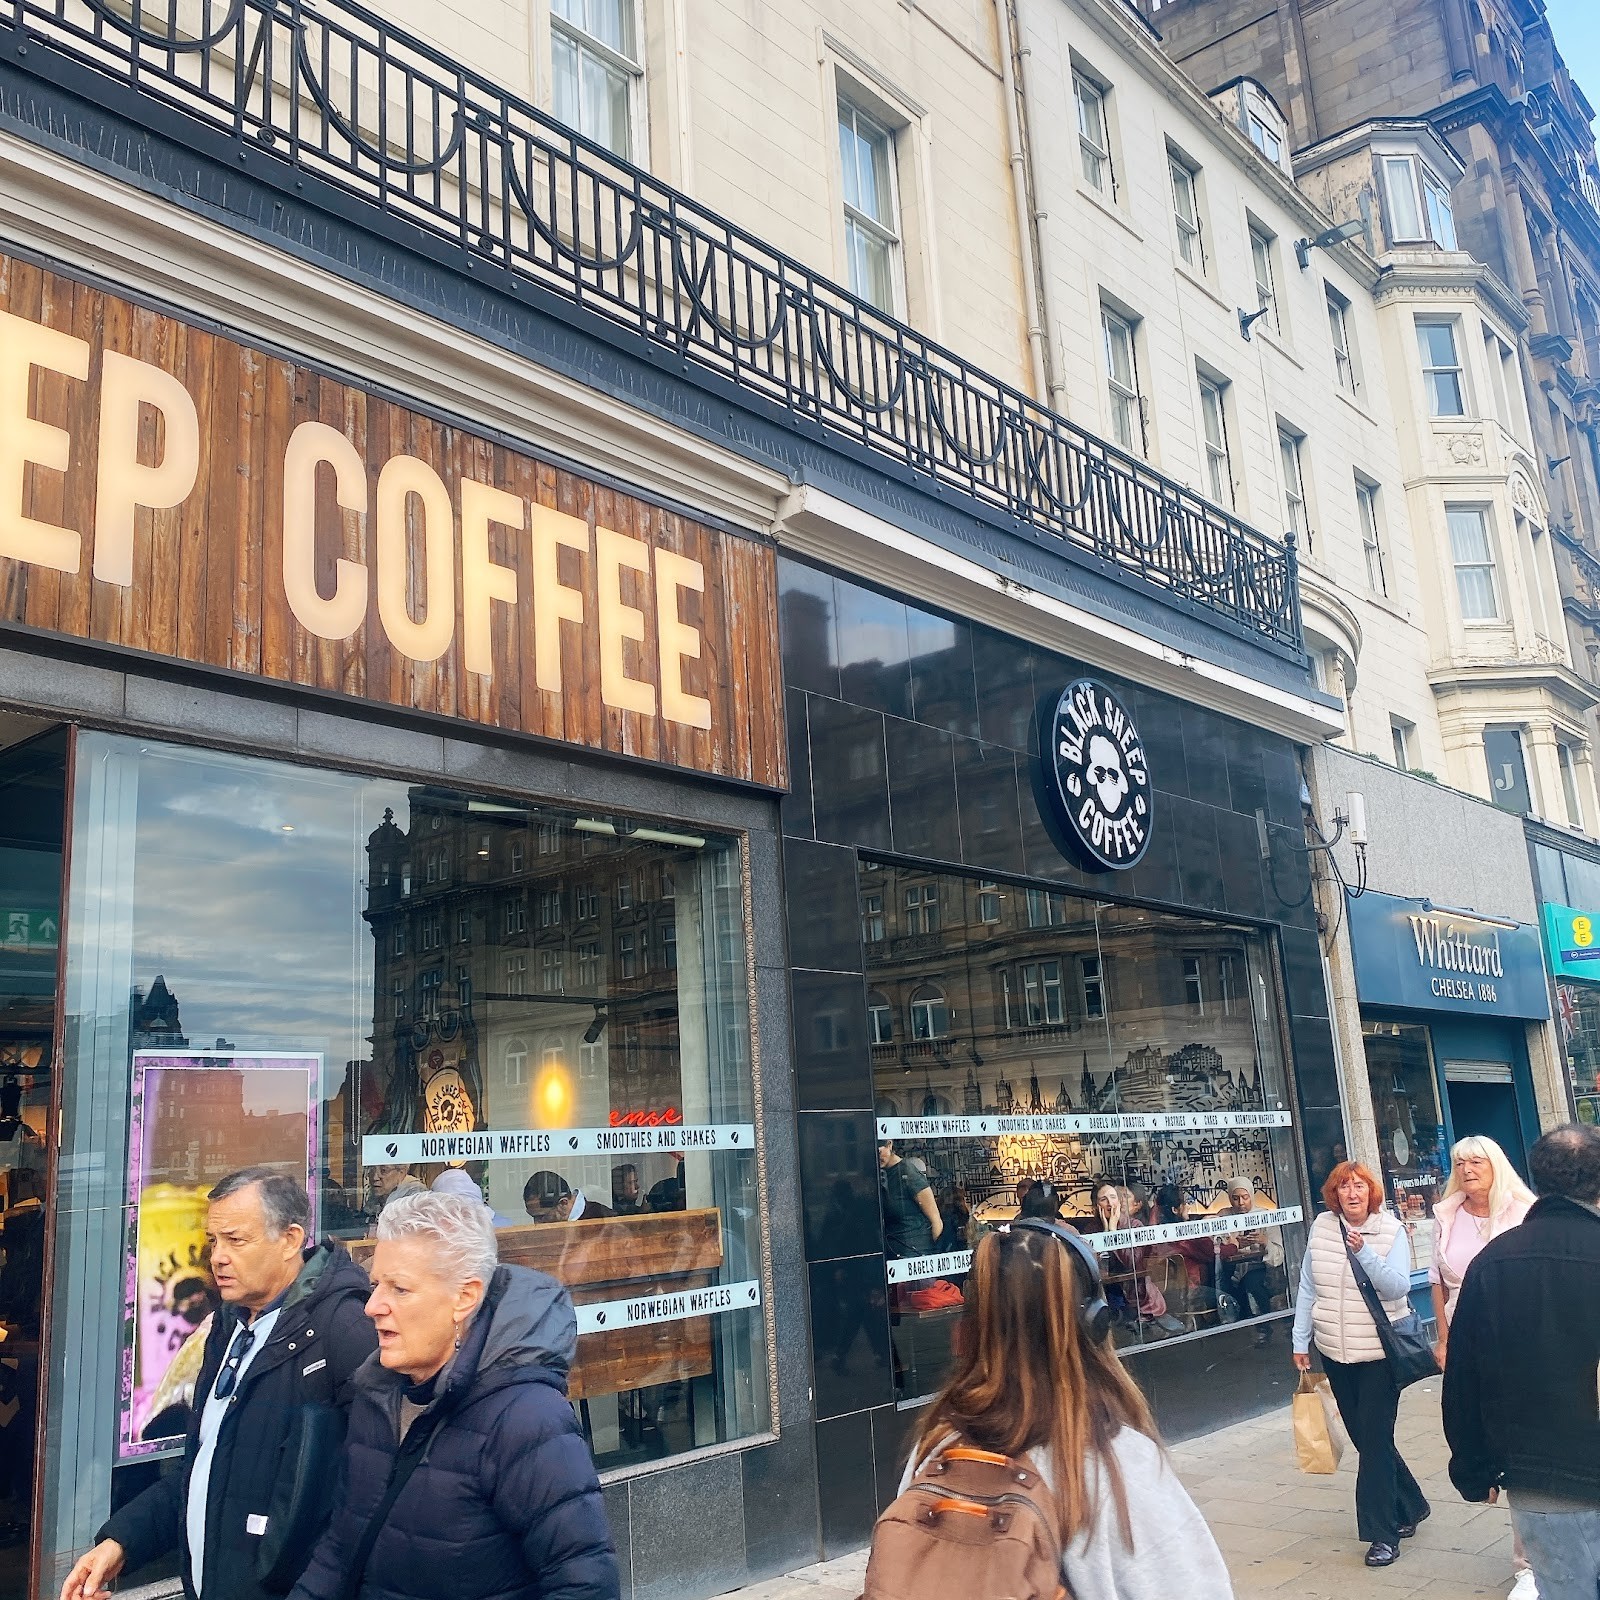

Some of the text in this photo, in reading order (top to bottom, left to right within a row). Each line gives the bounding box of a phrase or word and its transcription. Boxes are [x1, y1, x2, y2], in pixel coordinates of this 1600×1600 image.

[283, 421, 712, 731] COFFEE
[1060, 688, 1148, 786] BLACK SHEEP
[1495, 763, 1514, 791] J
[1078, 797, 1145, 858] COFFEE
[1408, 915, 1504, 978] Whittard
[1431, 977, 1497, 1003] CHELSEA 1886
[432, 1084, 461, 1124] BLACK SHEEP
[900, 1119, 971, 1134] NORWEGIAN WAFFLES
[997, 1117, 1067, 1131] SMOOTHIES AND SHAKES
[1089, 1117, 1109, 1129] BAGELS
[1122, 1116, 1145, 1127] TOASTIES
[420, 1134, 550, 1157] NORWEGIAN WAFFLES
[596, 1129, 716, 1150] SMOOTHIES AND SHAKES
[1103, 1229, 1156, 1248] NORWEGIAN WAFFLES
[907, 1259, 934, 1276] BAGELS
[937, 1257, 951, 1272] AND
[627, 1289, 731, 1321] NORWEGIAN WAFFLES
